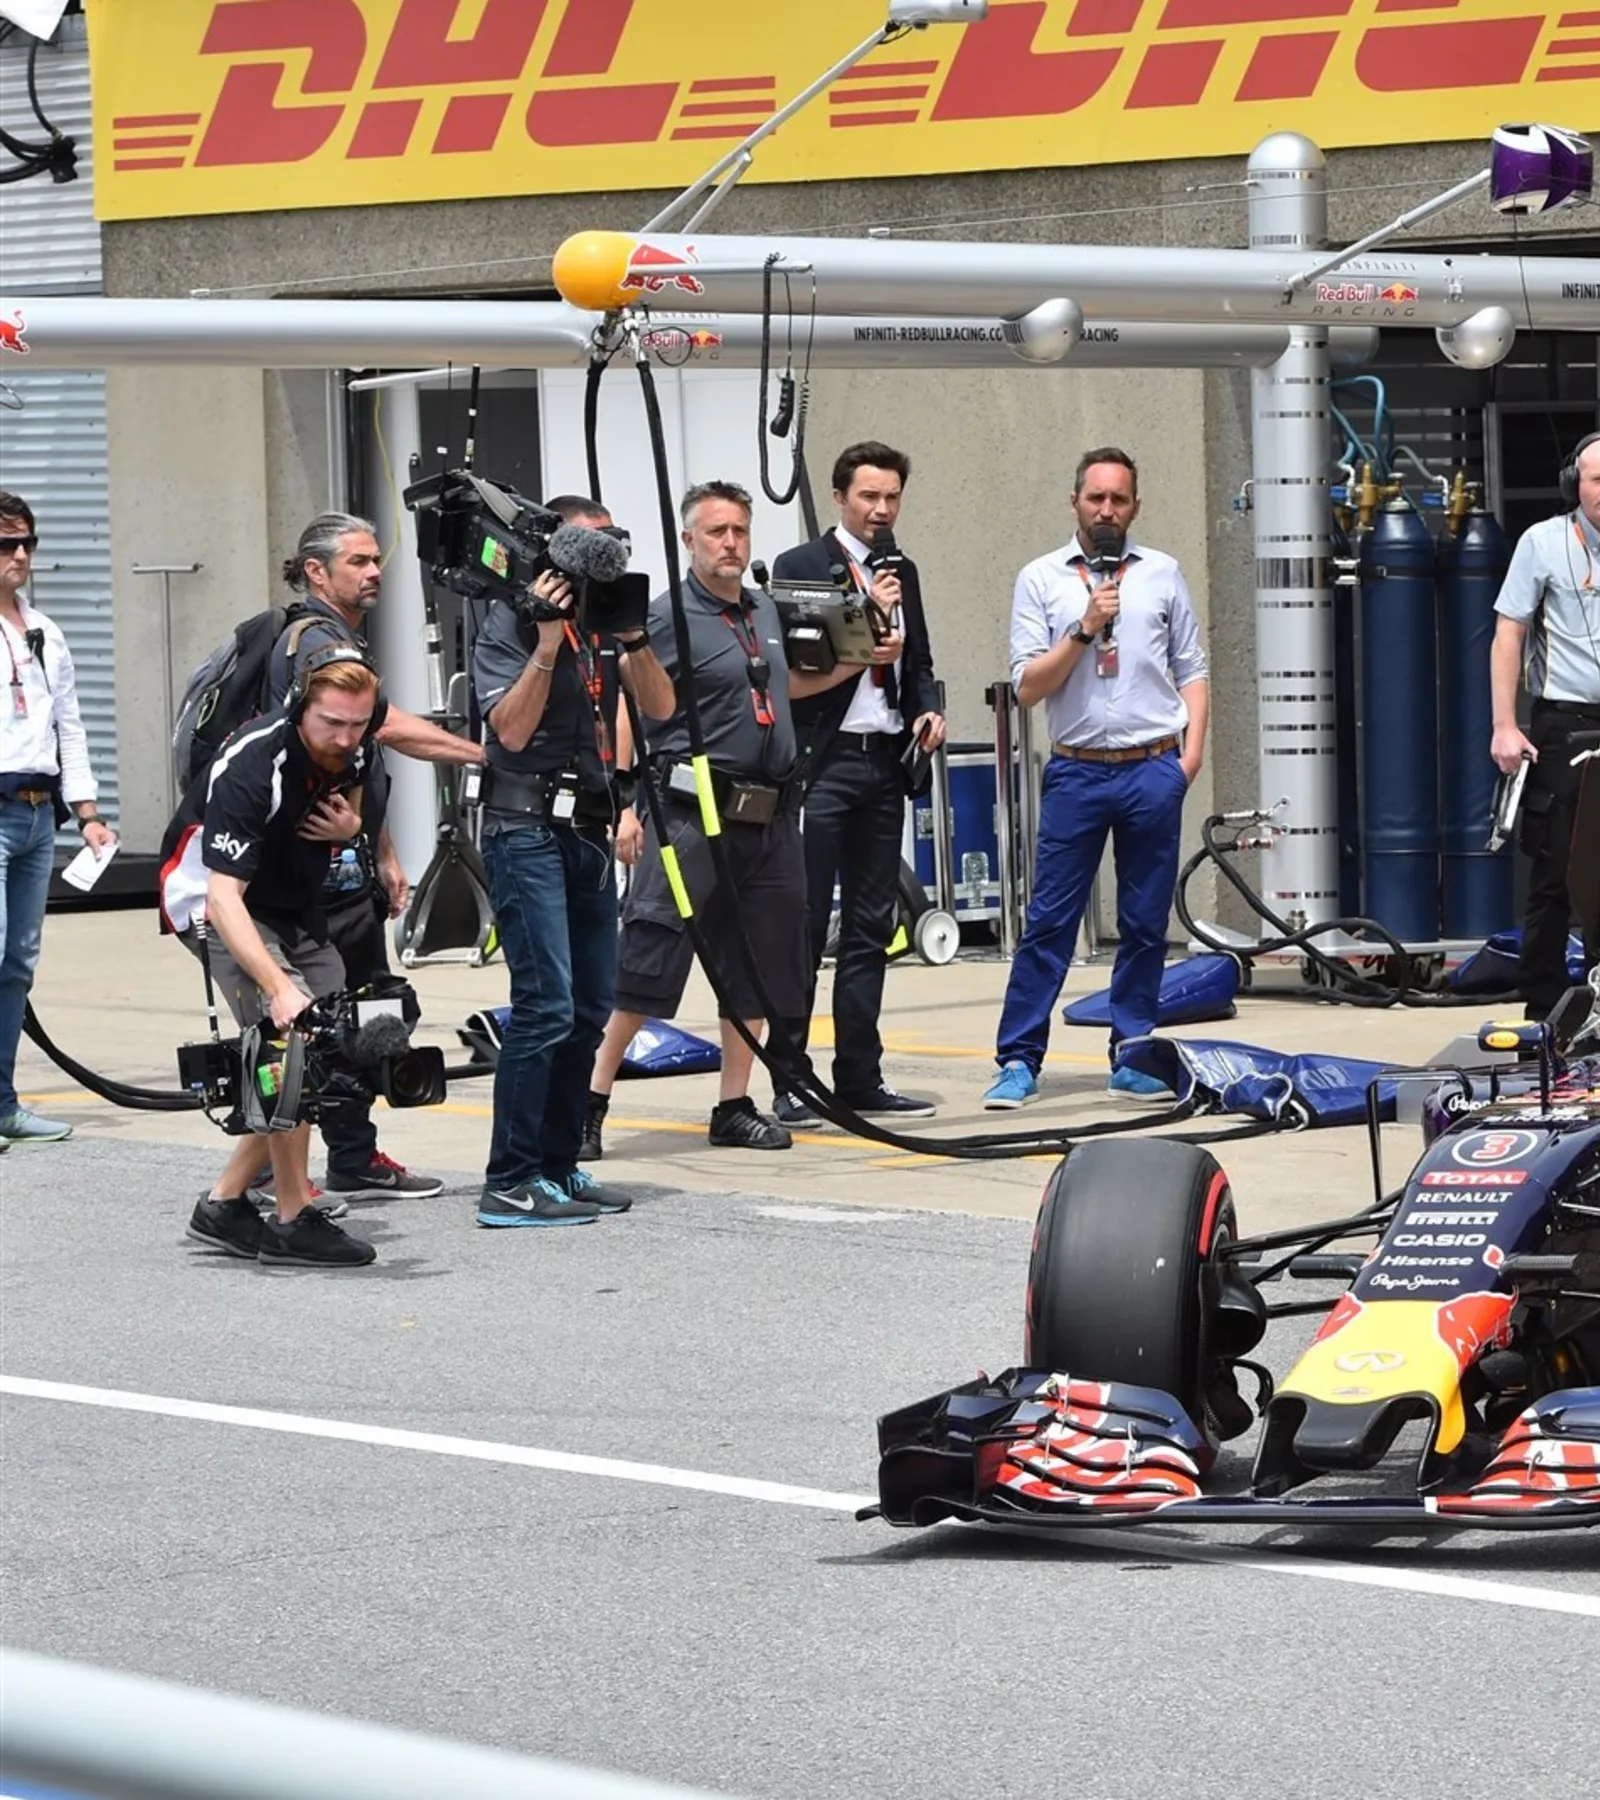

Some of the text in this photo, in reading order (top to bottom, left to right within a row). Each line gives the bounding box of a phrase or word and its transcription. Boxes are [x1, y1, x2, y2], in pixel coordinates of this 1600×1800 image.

[194, 0, 680, 167] DHL
[1316, 283, 1375, 302] Red Bull
[1311, 305, 1416, 317] RACING
[854, 326, 1119, 343] INFINITI-REDBULLRACING.CO RACING
[210, 831, 251, 861] sky
[1471, 1134, 1519, 1159] 3
[1430, 1172, 1521, 1185] TOTAL
[1416, 1192, 1513, 1203] RENAULT
[1405, 1211, 1499, 1225] PIRELLI
[1393, 1234, 1487, 1246] CASIO
[1380, 1255, 1474, 1266] Hisense
